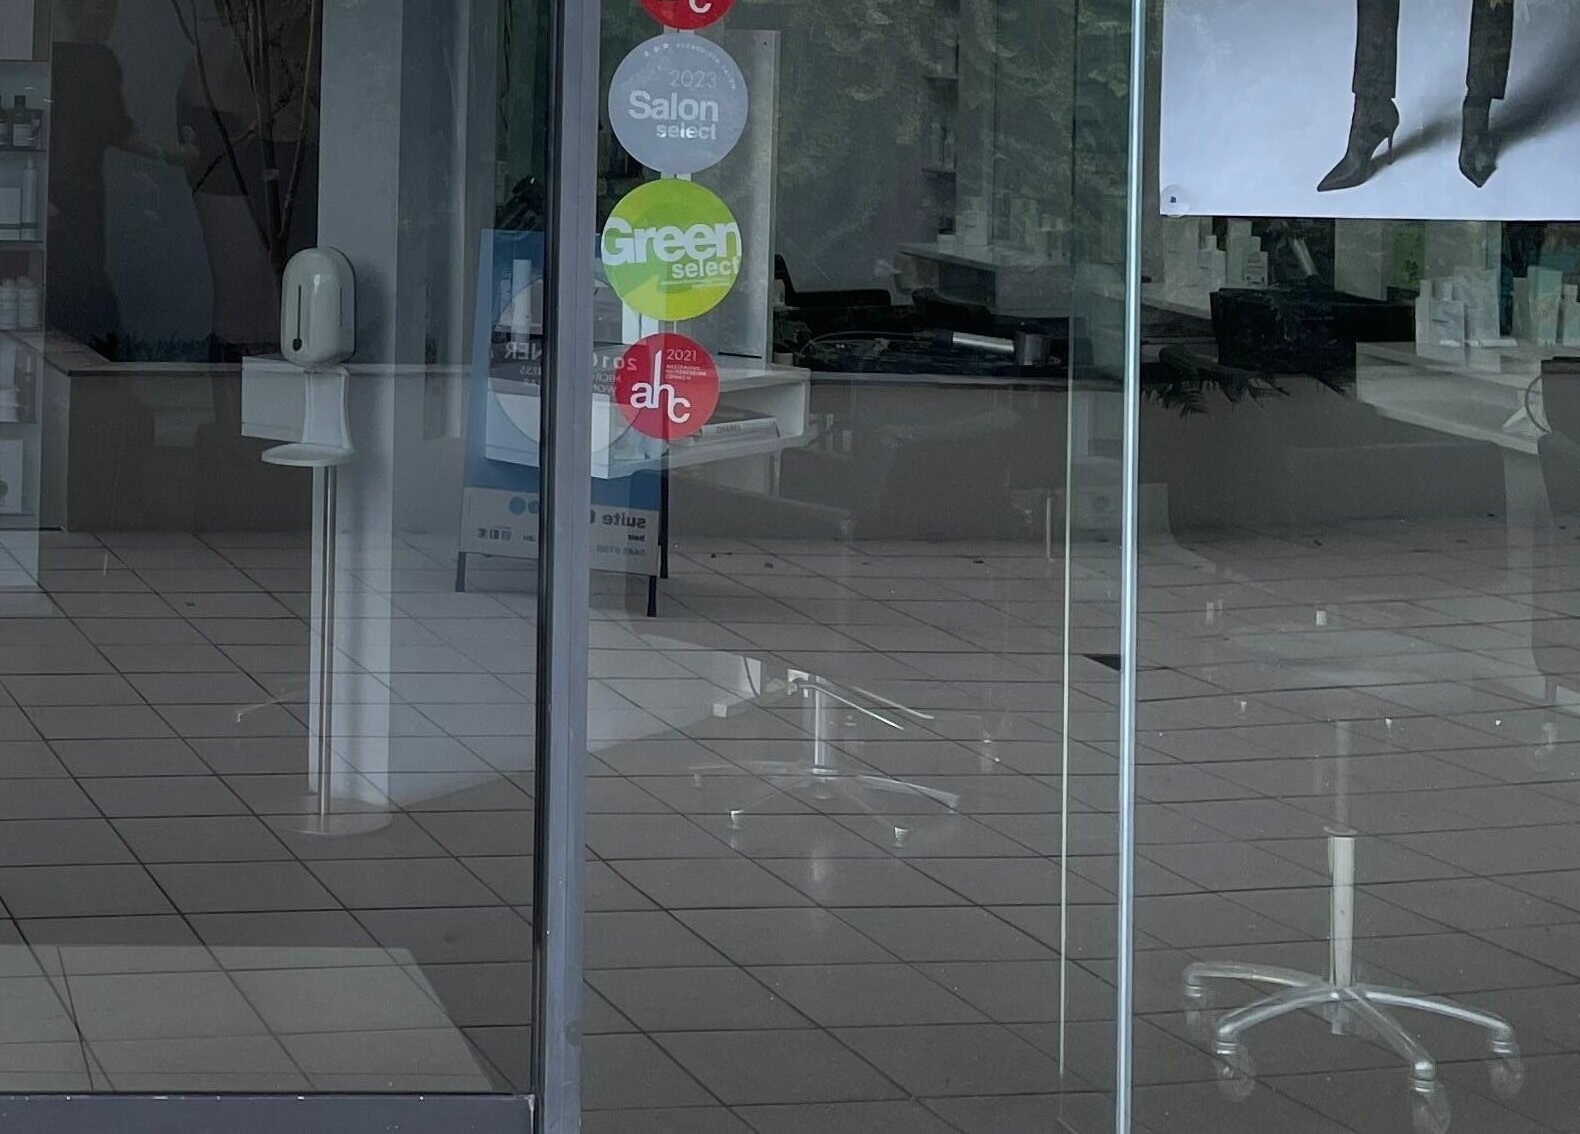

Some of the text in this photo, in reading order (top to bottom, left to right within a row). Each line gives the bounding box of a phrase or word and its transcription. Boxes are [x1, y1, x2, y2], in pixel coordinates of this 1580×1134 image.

[669, 69, 718, 89] 2023
[627, 89, 719, 123] Salon
[655, 122, 717, 141] select
[601, 216, 742, 266] Green
[672, 256, 741, 279] select
[665, 348, 698, 363] 2021
[629, 349, 692, 425] ahc
